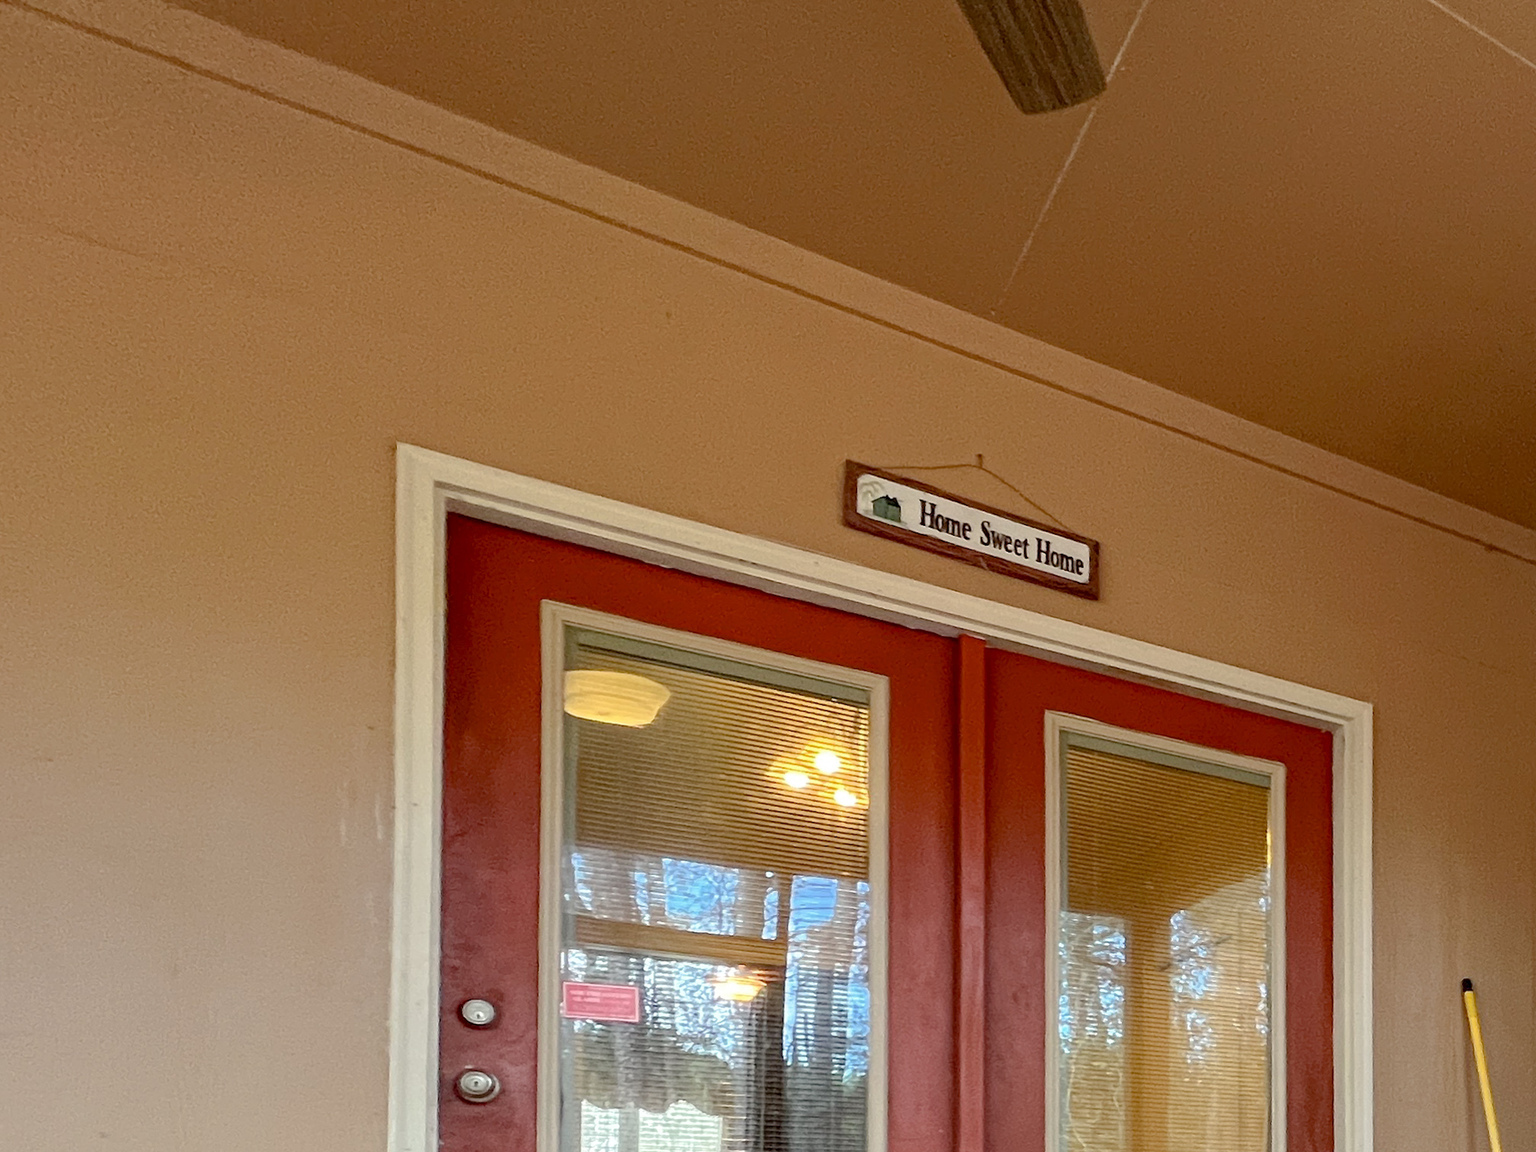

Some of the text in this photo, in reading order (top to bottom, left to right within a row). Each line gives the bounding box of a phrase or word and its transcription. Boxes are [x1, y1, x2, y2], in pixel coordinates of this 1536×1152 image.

[919, 498, 1085, 577] Home Sweet Home
